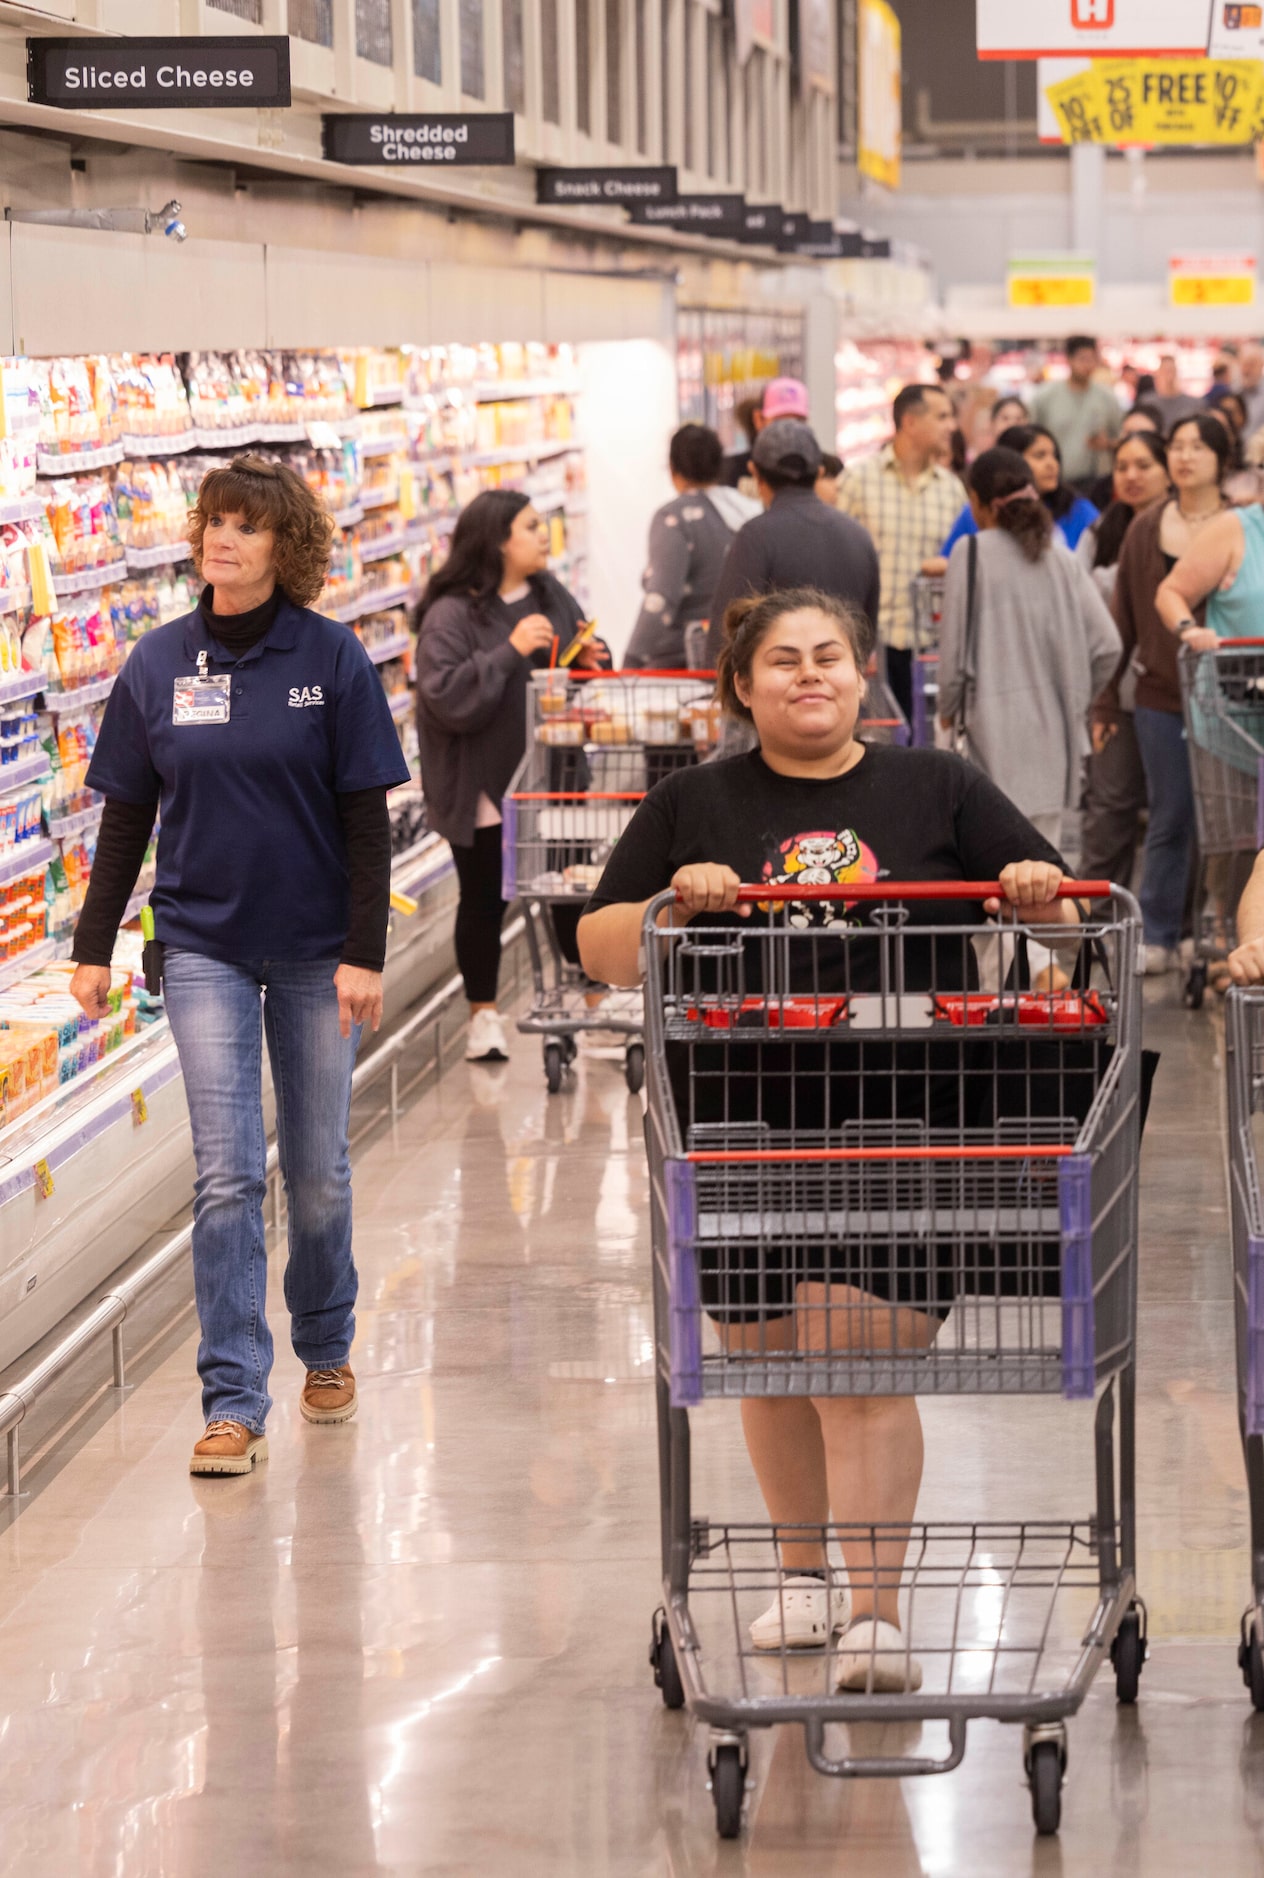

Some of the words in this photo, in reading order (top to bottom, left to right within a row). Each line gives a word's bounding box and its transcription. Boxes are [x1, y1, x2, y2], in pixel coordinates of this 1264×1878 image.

[64, 65, 147, 90] Sliced
[155, 65, 255, 90] Cheese
[1144, 73, 1206, 105] FREE
[369, 124, 468, 144] Shredded
[381, 143, 456, 161] Cheese
[554, 181, 601, 197] Snack
[604, 181, 661, 197] Cheese
[288, 685, 323, 702] SAS
